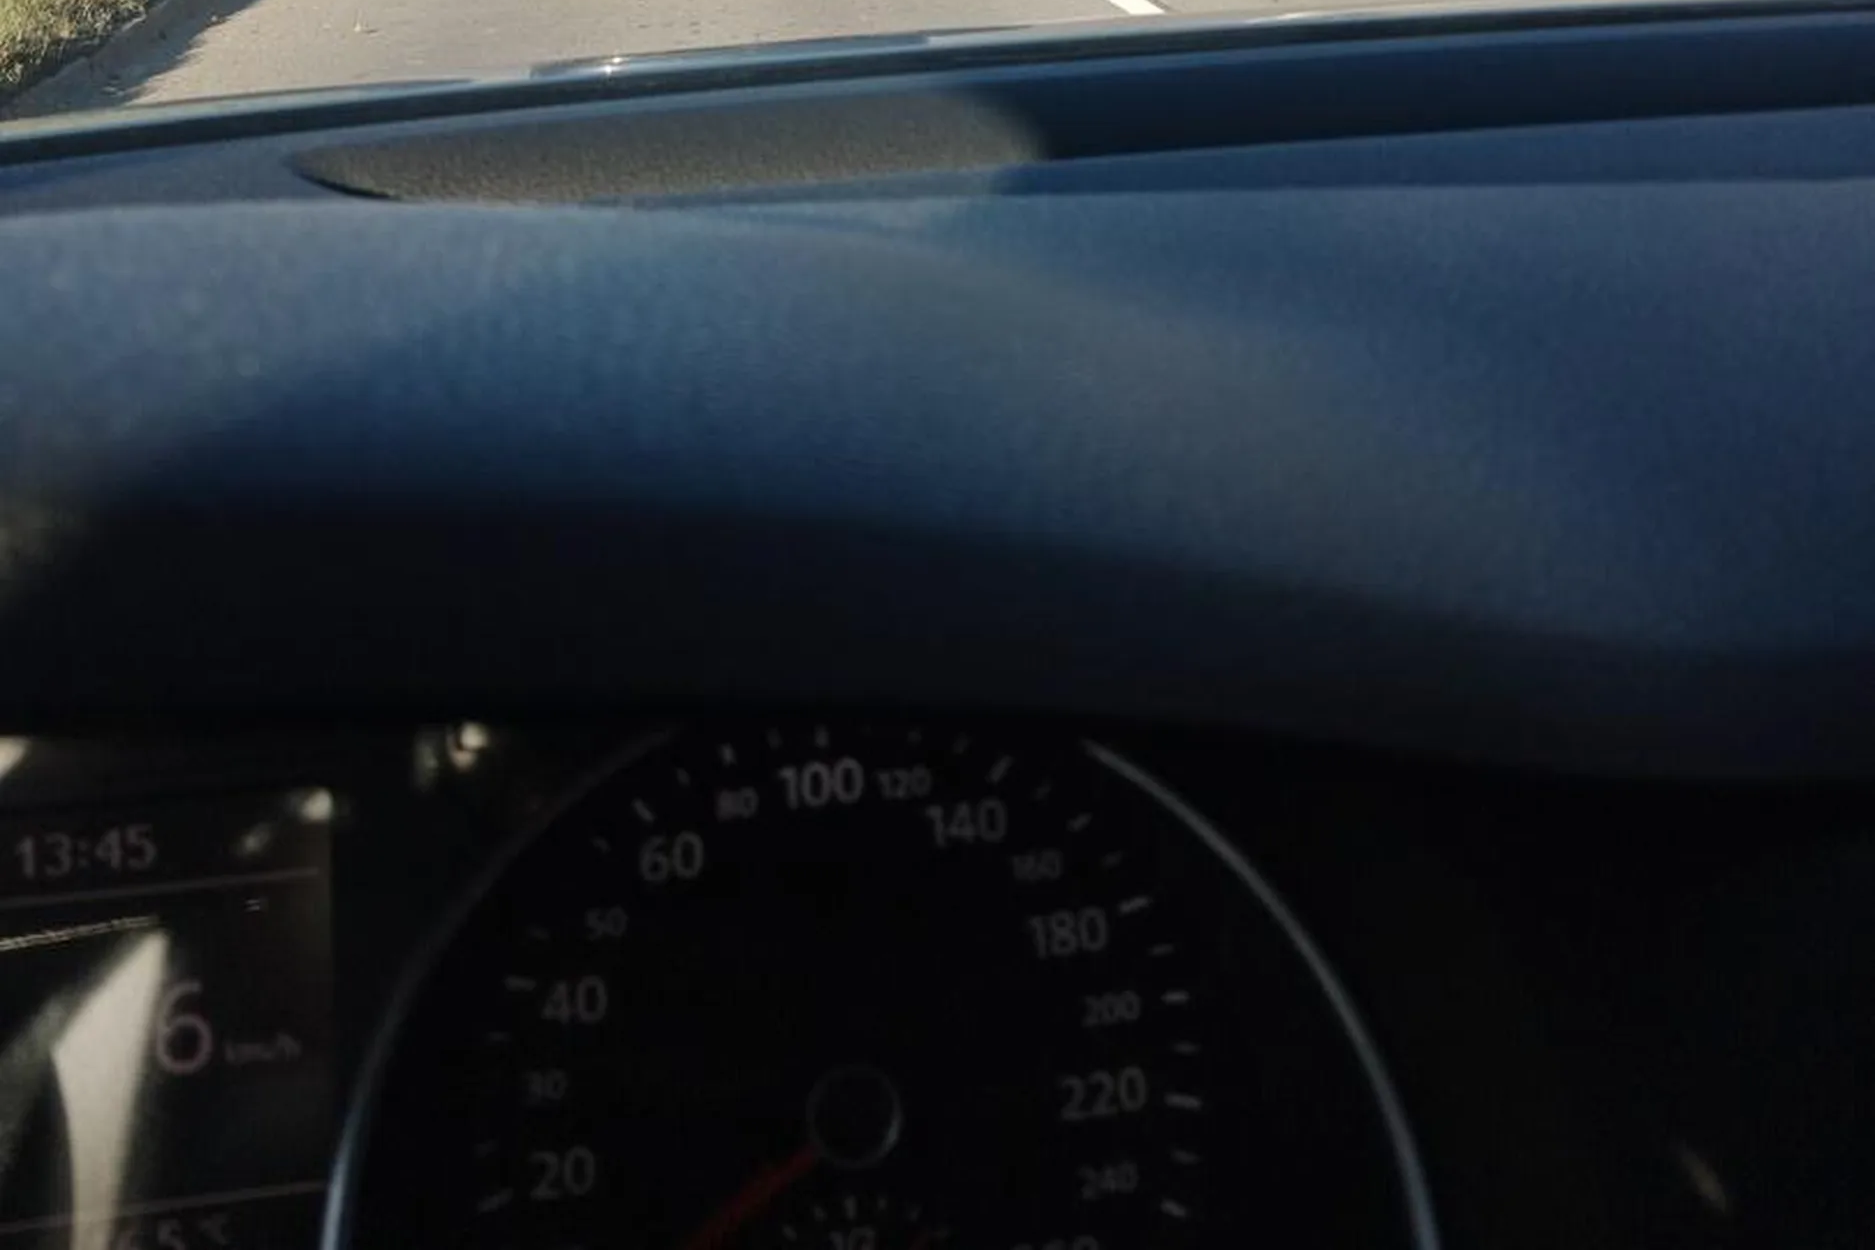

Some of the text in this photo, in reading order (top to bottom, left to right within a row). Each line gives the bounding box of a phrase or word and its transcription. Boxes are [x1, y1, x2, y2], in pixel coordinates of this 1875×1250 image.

[715, 786, 760, 823] 80
[777, 754, 865, 811] 100
[874, 763, 934, 800] 120
[924, 795, 1009, 848] 140
[14, 823, 159, 880] 13:45
[638, 830, 705, 884] 60
[1011, 848, 1064, 882] 160
[584, 905, 630, 942] 50
[1026, 904, 1109, 959] 180
[540, 974, 609, 1025] 40
[1081, 989, 1142, 1028] 200
[156, 978, 213, 1075] 6
[526, 1068, 569, 1106] 30
[1058, 1064, 1149, 1122] 220
[529, 1146, 596, 1202] 20
[1077, 1159, 1139, 1201] 240
